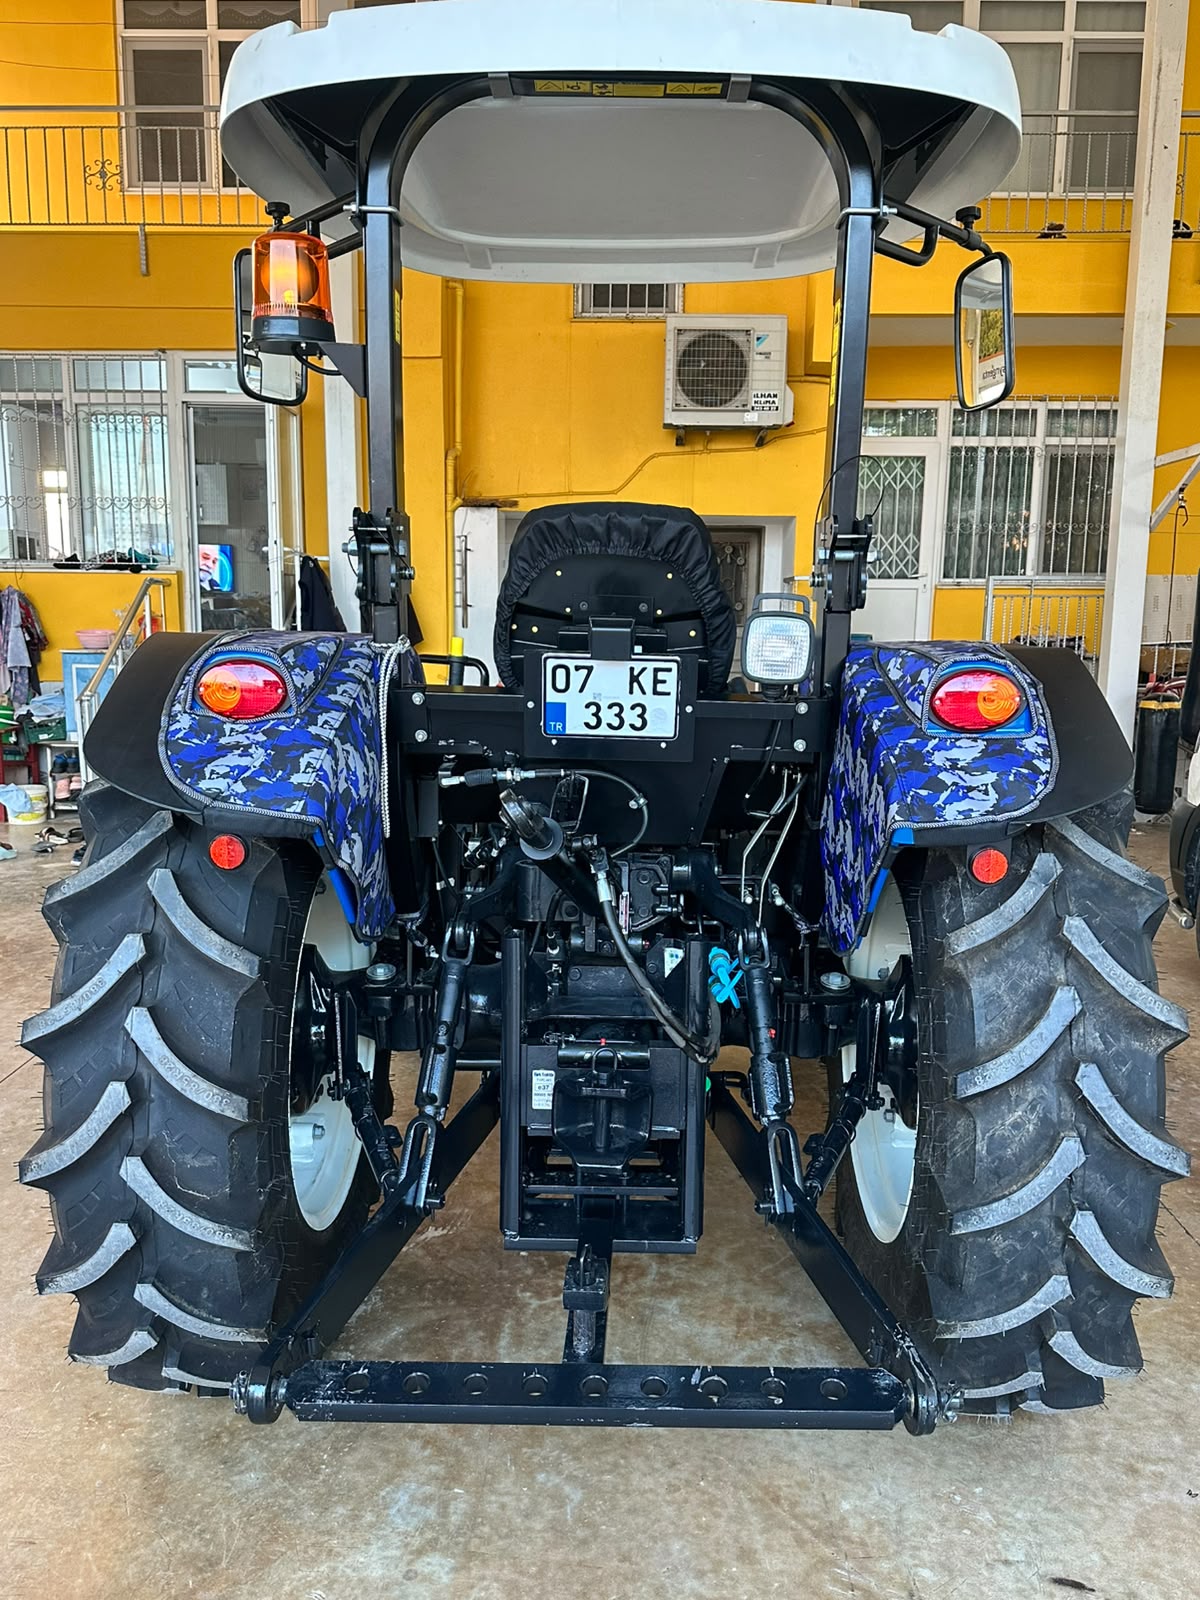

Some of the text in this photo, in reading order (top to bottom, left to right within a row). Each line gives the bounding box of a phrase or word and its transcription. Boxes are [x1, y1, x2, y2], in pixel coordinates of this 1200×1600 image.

[551, 664, 673, 696] 07 KE
[549, 722, 563, 732] TR
[583, 701, 648, 732] 333
[159, 1054, 231, 1107] 380/85R28
